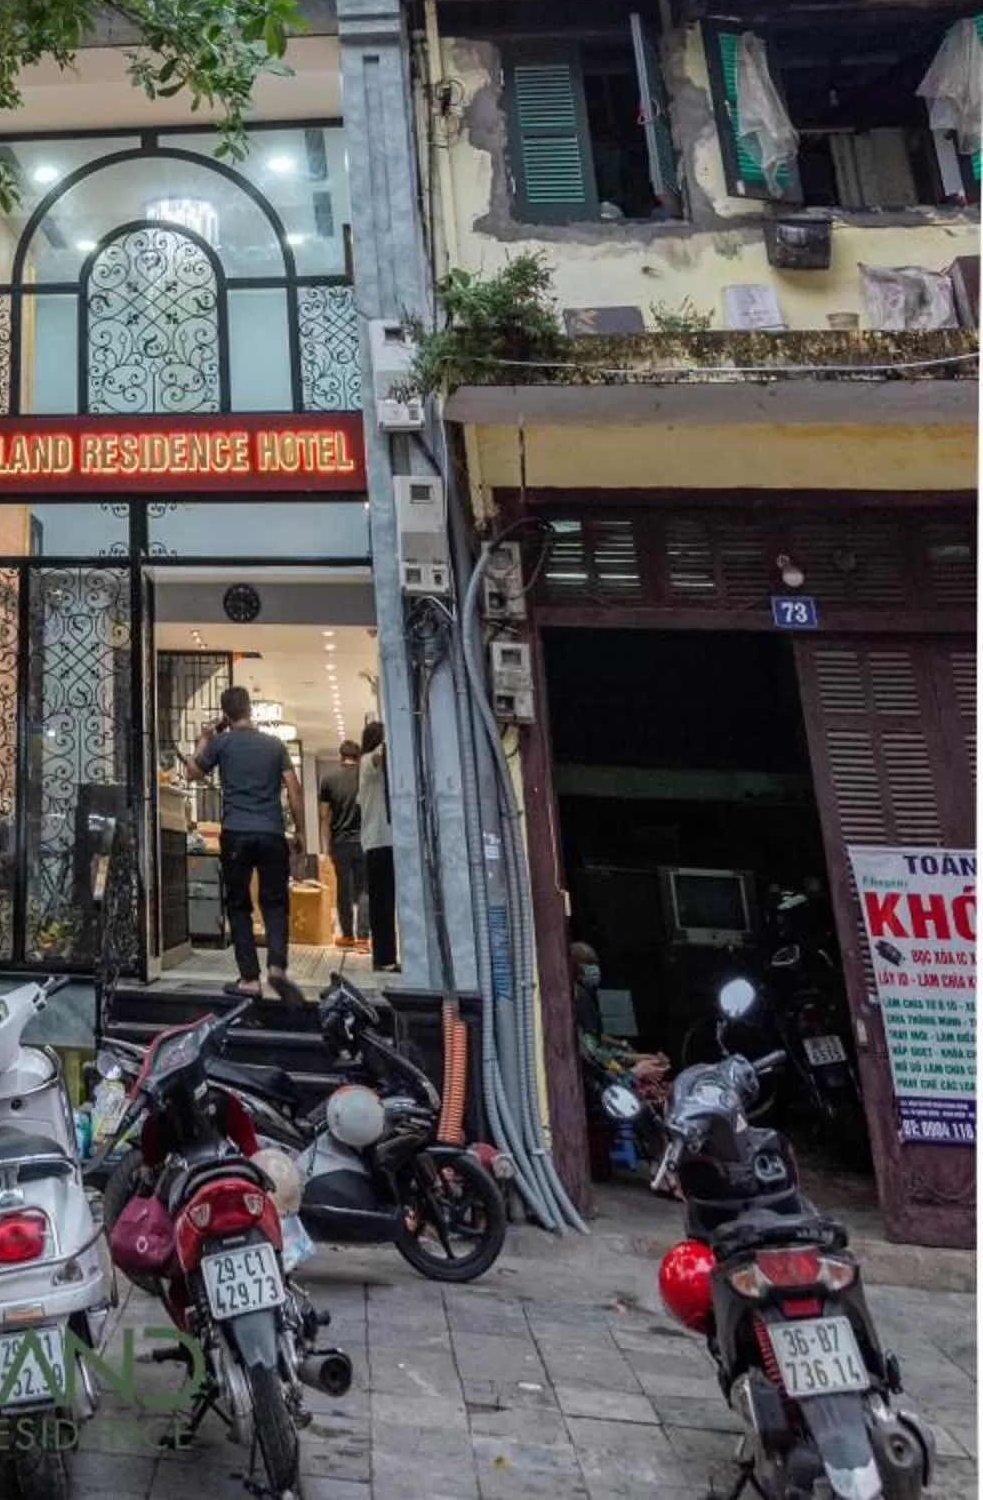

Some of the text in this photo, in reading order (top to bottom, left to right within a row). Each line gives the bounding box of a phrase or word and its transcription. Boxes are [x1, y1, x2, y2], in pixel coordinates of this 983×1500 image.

[80, 432, 250, 473] RESIDENCE
[258, 430, 354, 471] HOTEL
[781, 602, 808, 622] 73
[213, 1251, 266, 1285] 29-C1
[216, 1275, 279, 1314] 429.73
[785, 1355, 862, 1390] 736.14
